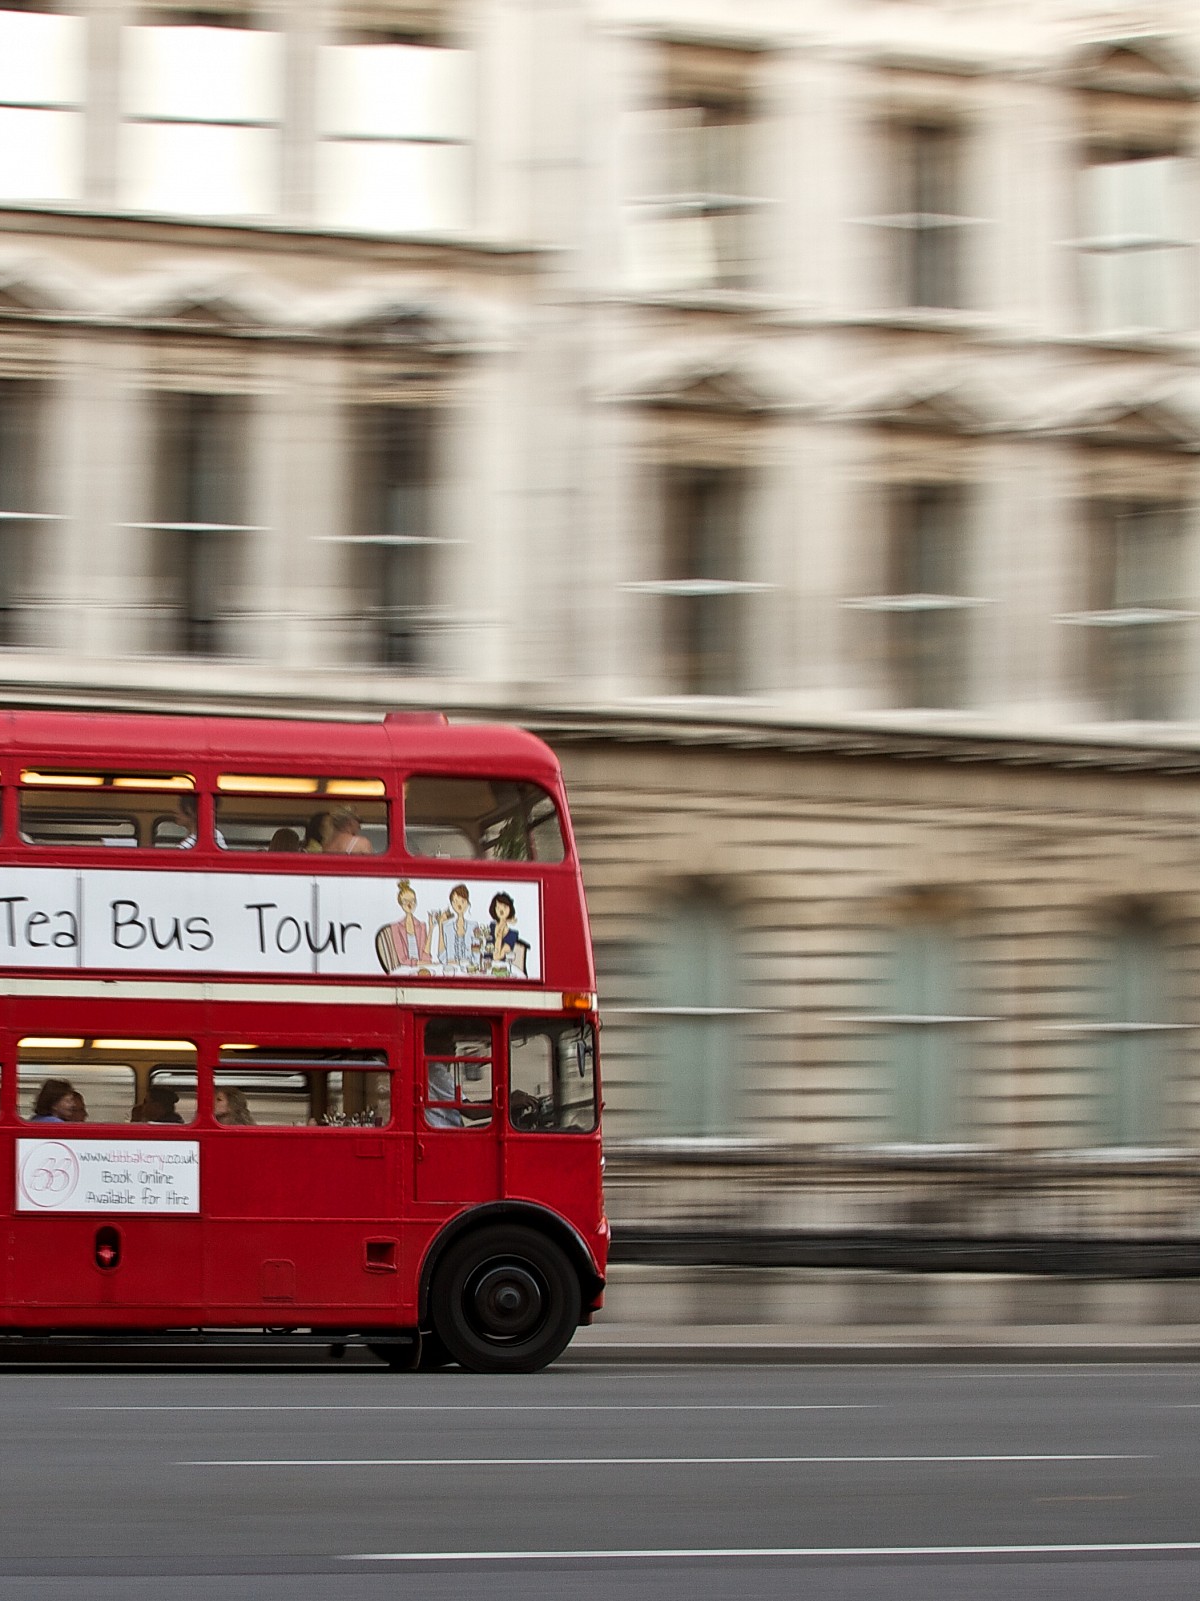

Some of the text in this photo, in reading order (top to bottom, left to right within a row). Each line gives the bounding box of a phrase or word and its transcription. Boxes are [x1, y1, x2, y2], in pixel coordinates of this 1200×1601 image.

[110, 899, 215, 951] Bus
[245, 902, 363, 955] Tour
[101, 1169, 174, 1185] Book Online
[85, 1187, 190, 1206] Available for Hire
